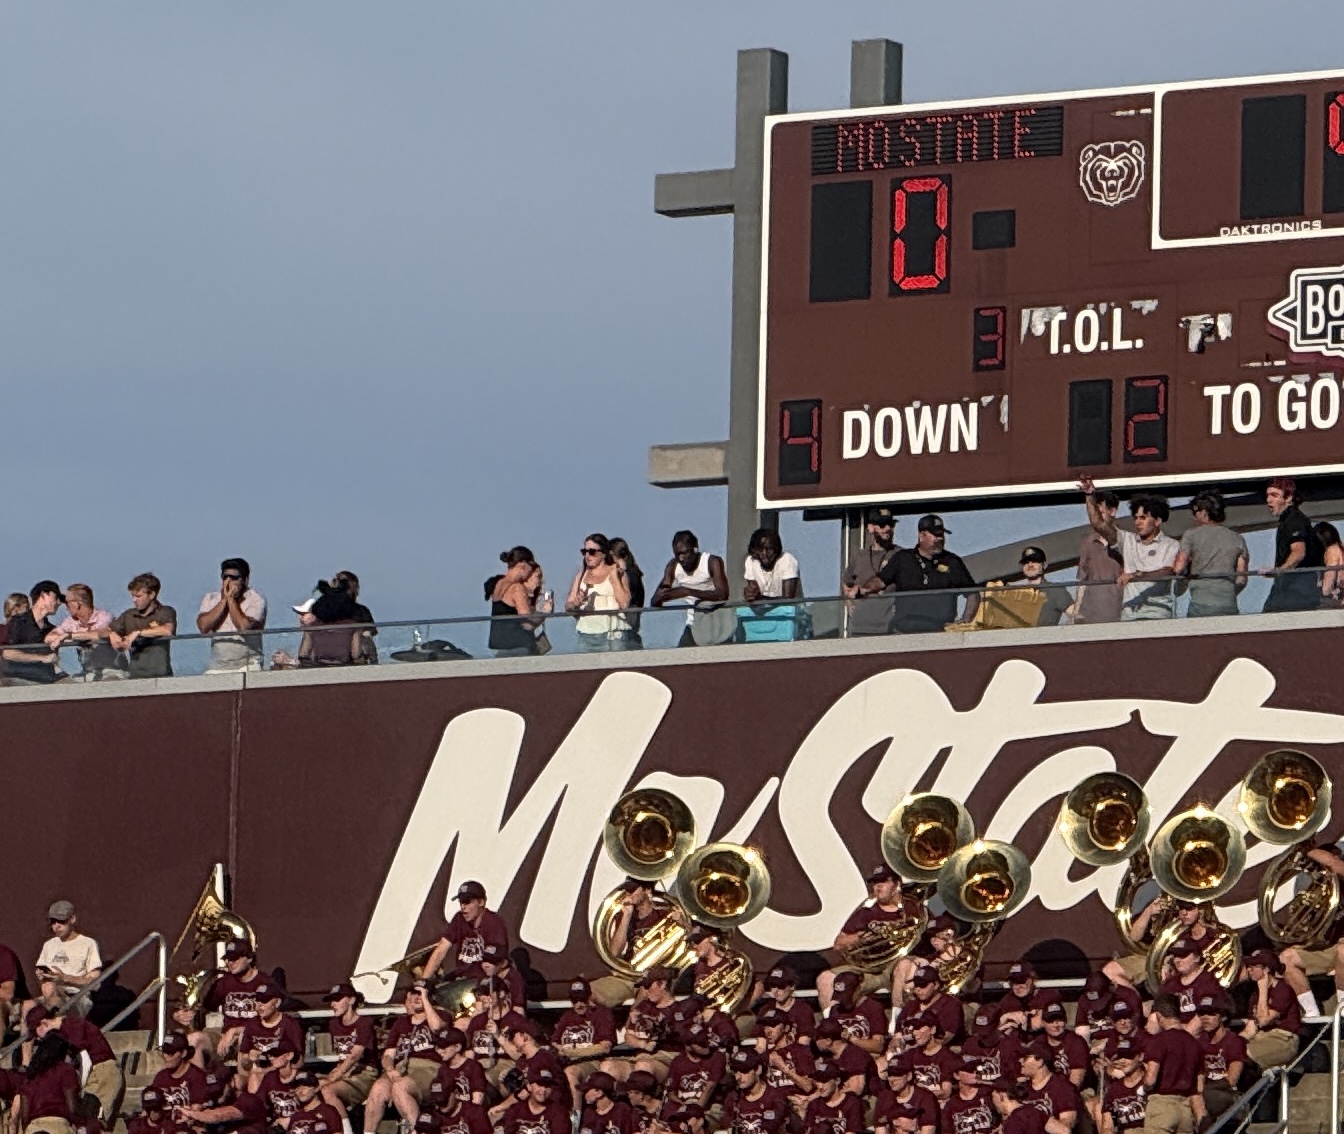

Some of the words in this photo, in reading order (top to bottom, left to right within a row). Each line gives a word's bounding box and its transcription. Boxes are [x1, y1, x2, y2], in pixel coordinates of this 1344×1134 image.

[892, 176, 948, 291] 0
[978, 307, 1004, 367] 3
[1047, 306, 1144, 355] T.O.L.
[842, 403, 979, 459] DOWN
[1127, 379, 1165, 455] 2
[1204, 382, 1260, 436] TO
[1278, 377, 1340, 430] GO
[782, 405, 819, 472] 4
